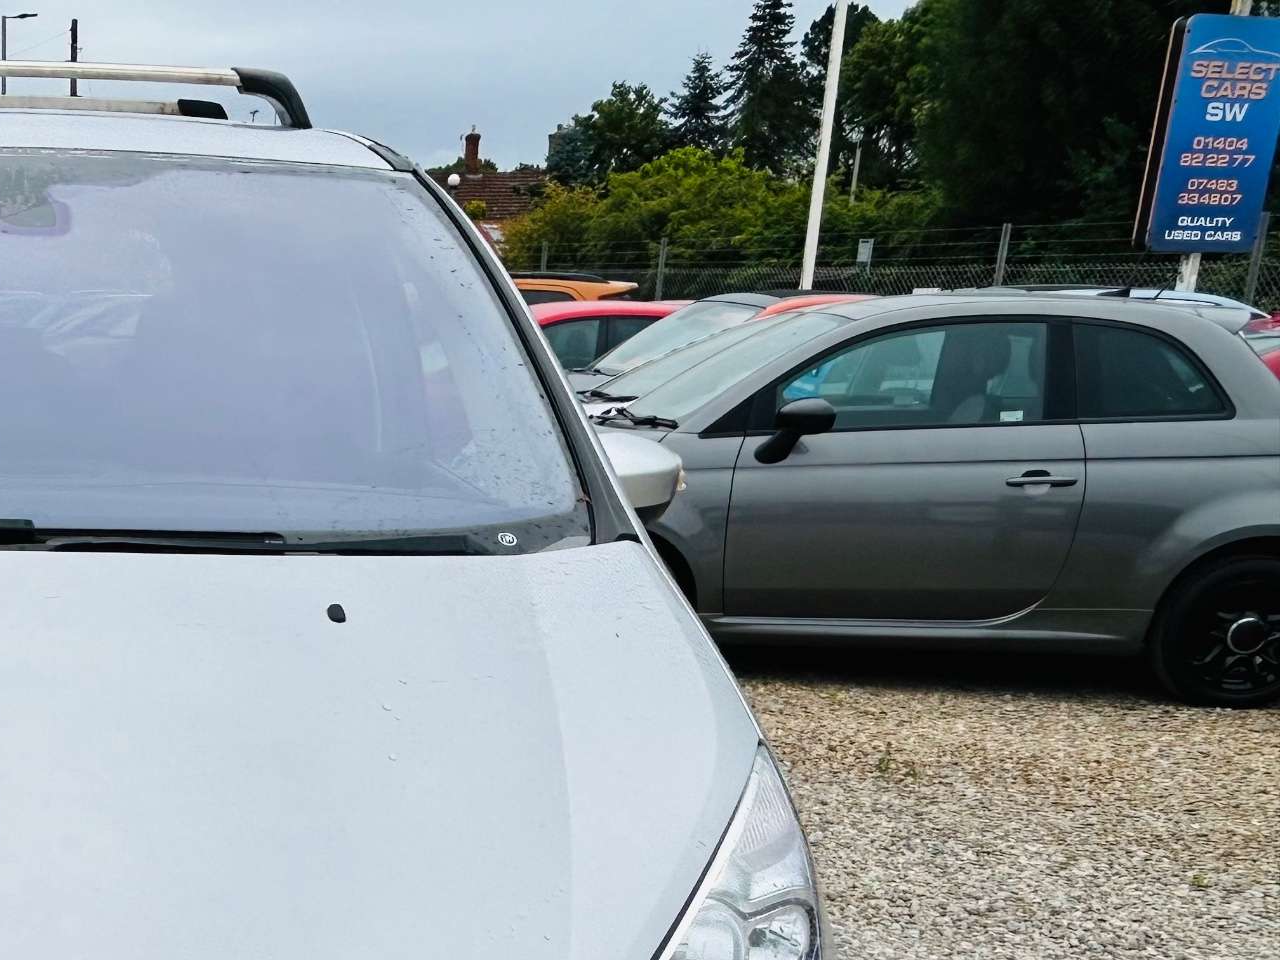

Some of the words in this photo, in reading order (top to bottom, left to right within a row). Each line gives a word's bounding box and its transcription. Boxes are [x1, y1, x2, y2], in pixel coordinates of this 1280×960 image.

[1191, 61, 1280, 80] SELECT
[1201, 80, 1268, 99] CARS
[1205, 102, 1248, 122] SW
[1192, 136, 1248, 150] 01404
[1187, 178, 1238, 191] 07483
[1177, 193, 1243, 205] 334807
[1177, 216, 1234, 227] QUALITY
[1164, 230, 1201, 240] USED
[1204, 230, 1242, 241] CARS
